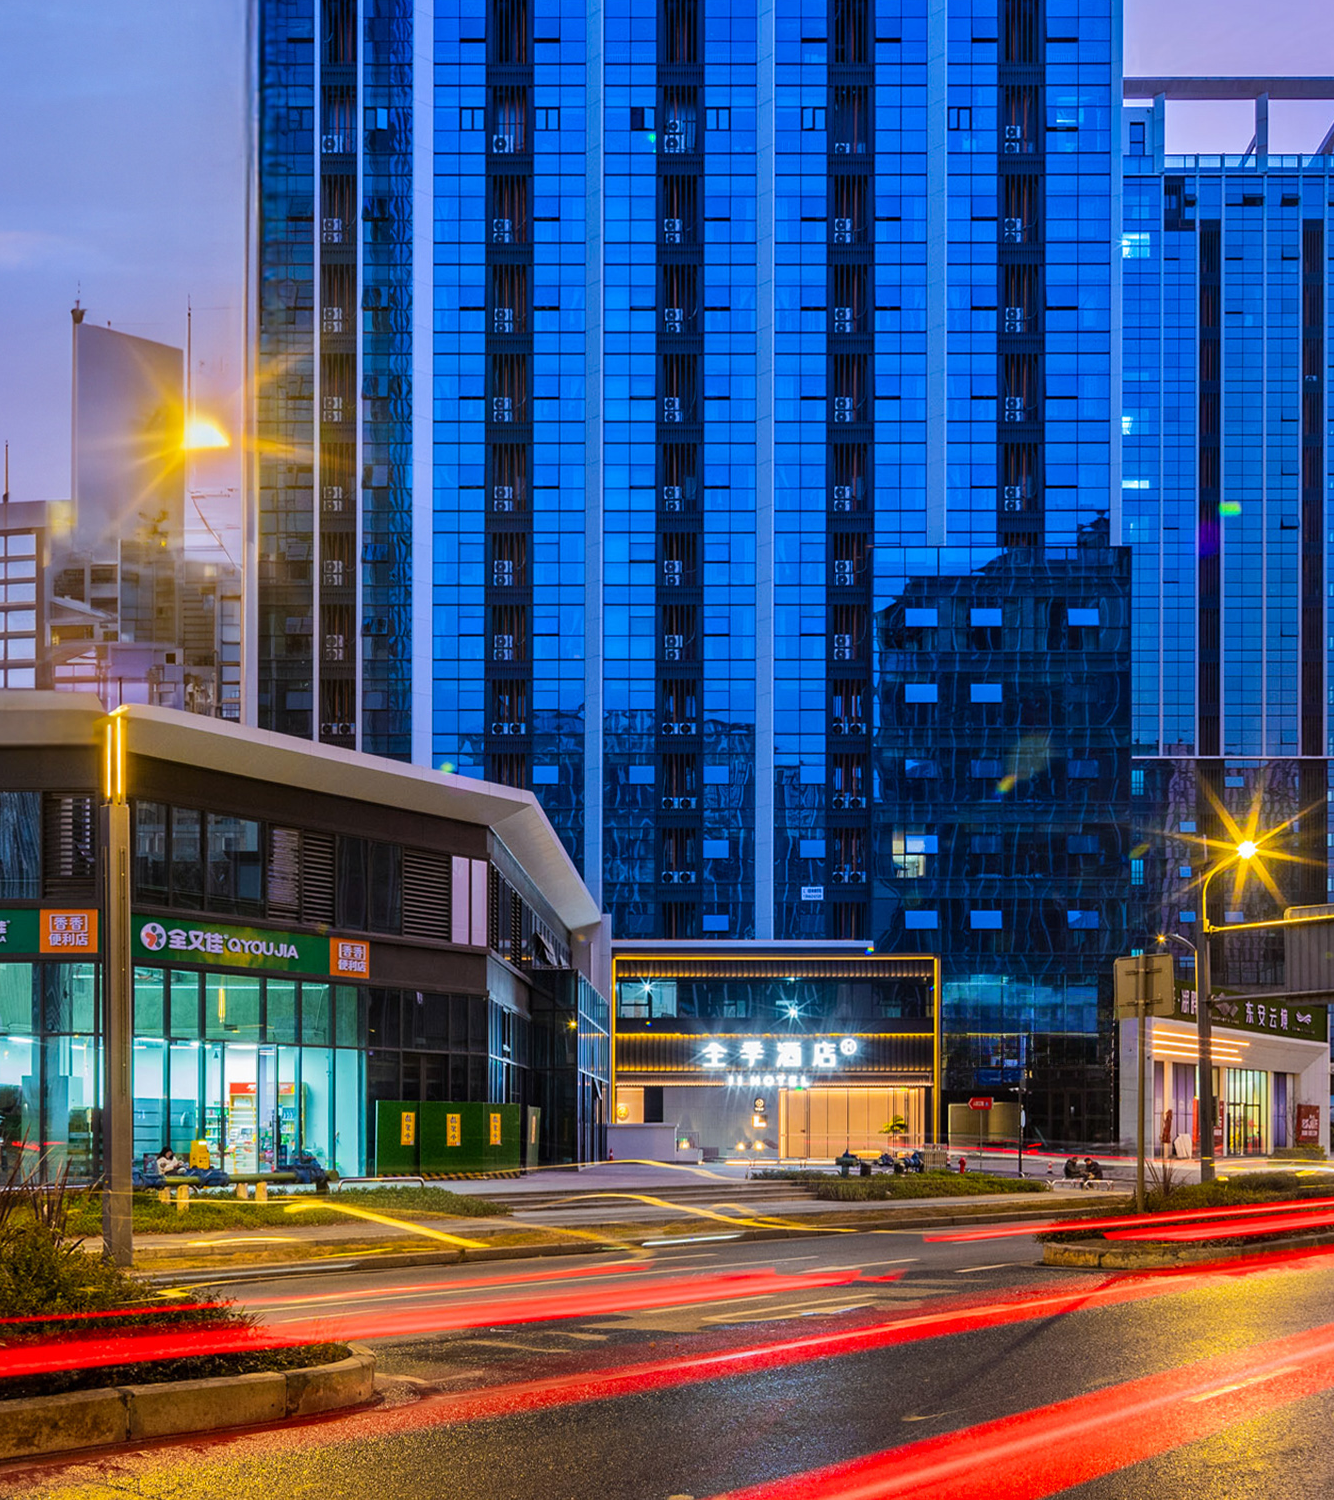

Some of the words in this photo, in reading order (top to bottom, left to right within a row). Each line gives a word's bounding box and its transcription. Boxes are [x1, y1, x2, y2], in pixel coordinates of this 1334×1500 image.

[48, 933, 88, 946] 便利店
[168, 928, 224, 954] 全又佳
[337, 960, 366, 973] 便利店
[702, 1040, 837, 1067] 全季酒店
[749, 1074, 811, 1087] HOTEL
